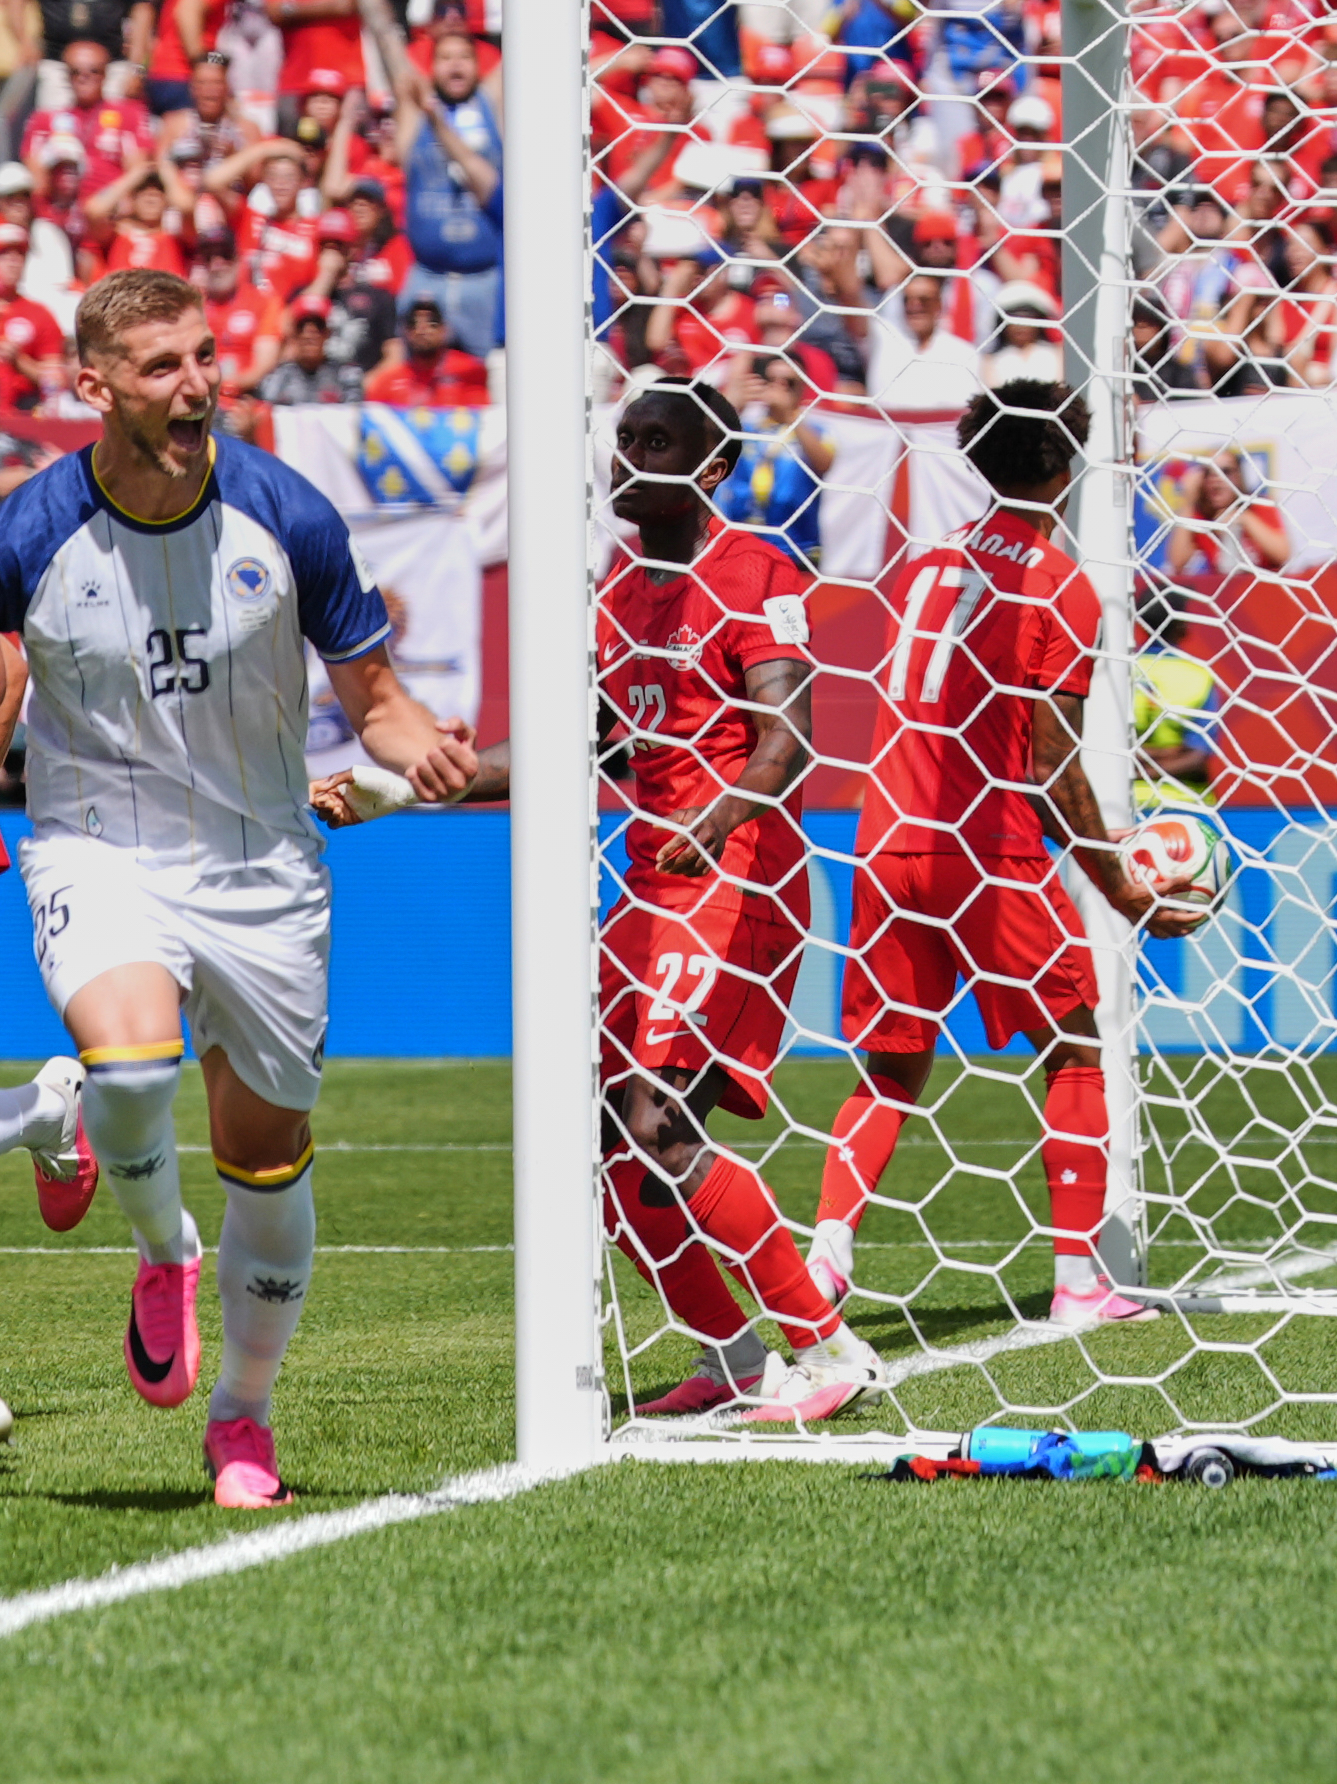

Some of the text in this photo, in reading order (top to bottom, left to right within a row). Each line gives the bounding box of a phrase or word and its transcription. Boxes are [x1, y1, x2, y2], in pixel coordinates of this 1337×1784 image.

[147, 629, 209, 698] 25
[888, 566, 993, 703] 17
[628, 684, 666, 752] 22
[35, 885, 74, 965] 25
[648, 952, 718, 1027] 22
